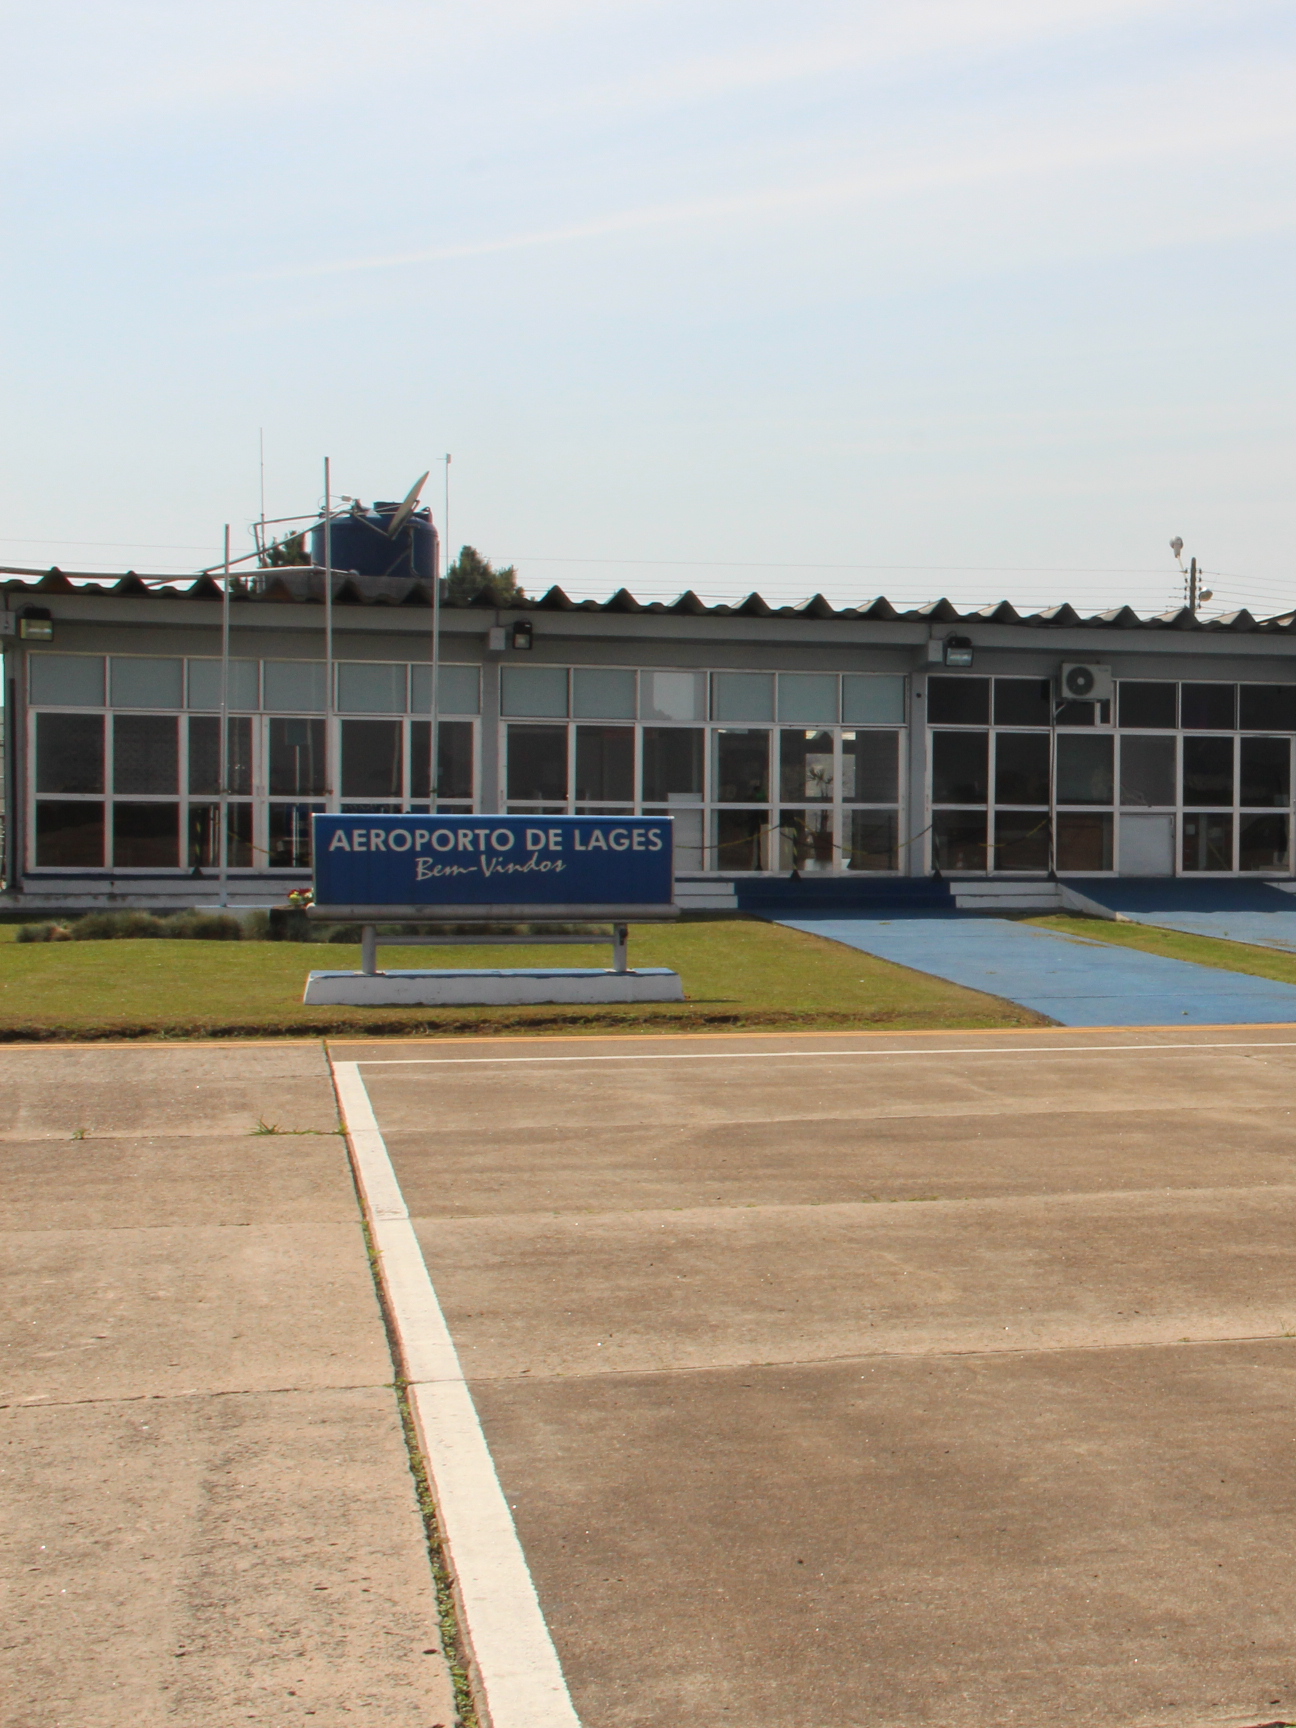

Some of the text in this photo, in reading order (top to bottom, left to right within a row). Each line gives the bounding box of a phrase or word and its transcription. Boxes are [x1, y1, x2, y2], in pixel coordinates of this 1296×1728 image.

[329, 829, 663, 851] AEROPORTO DE LAGES
[415, 852, 567, 881] Bem-Vindos
